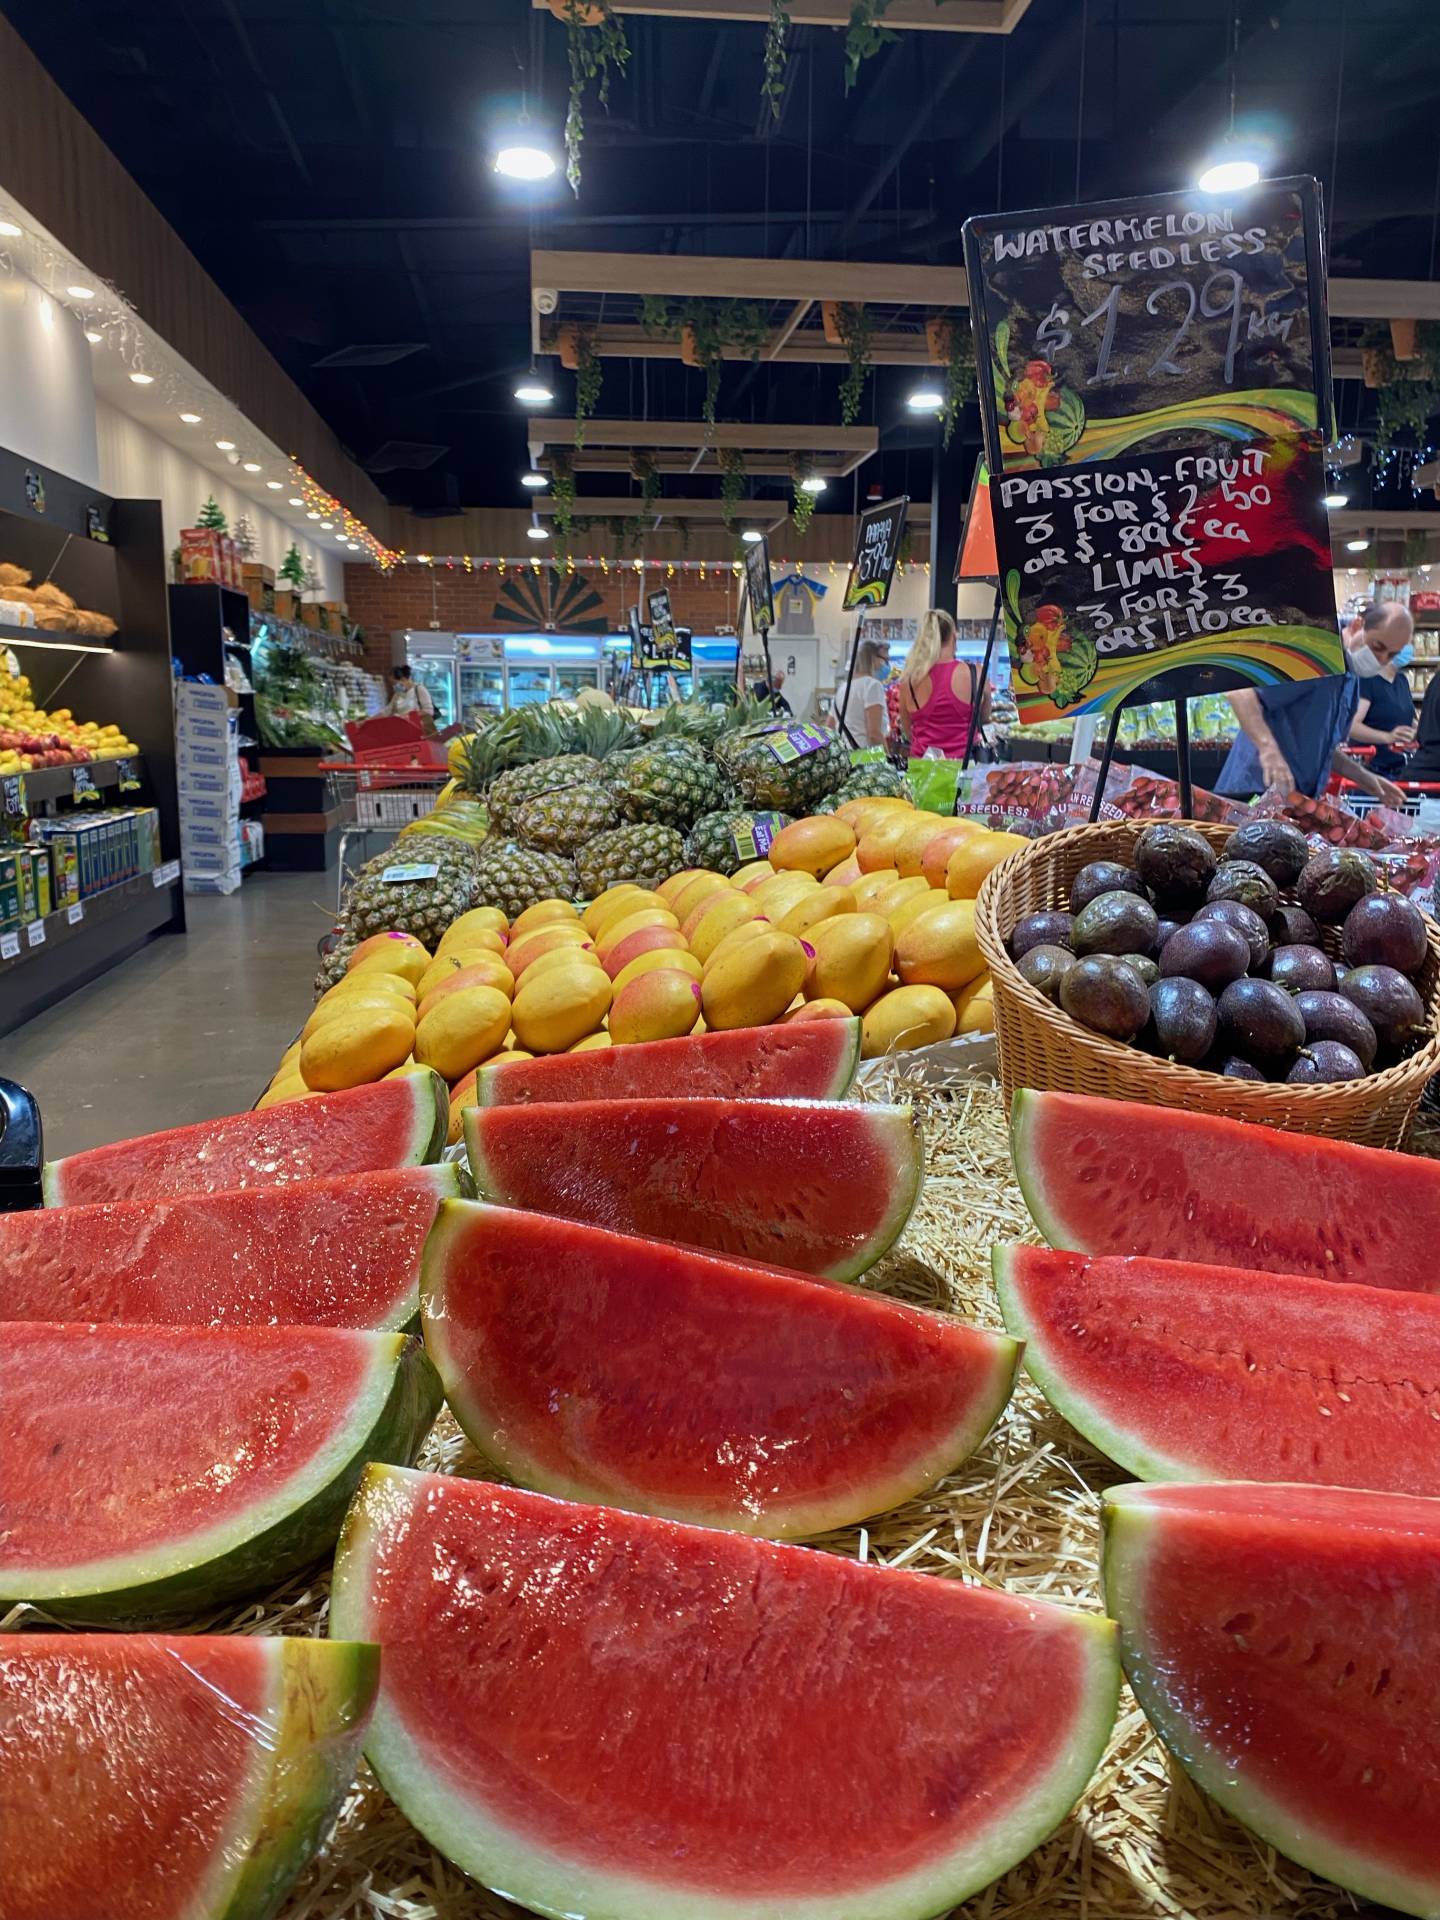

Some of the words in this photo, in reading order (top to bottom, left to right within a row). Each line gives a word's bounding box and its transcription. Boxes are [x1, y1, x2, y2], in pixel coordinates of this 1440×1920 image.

[993, 208, 1235, 264] WATERMELON
[1081, 227, 1268, 279] SEEDLESS
[1036, 268, 1244, 385] $1.29
[1014, 511, 1055, 545] 3
[1073, 499, 1141, 531] FOR
[1023, 546, 1069, 575] OR
[1093, 547, 1203, 592] LIMES
[1076, 602, 1114, 630] 3
[1120, 586, 1182, 620] FOR
[969, 804, 1030, 818] SEEDLESS
